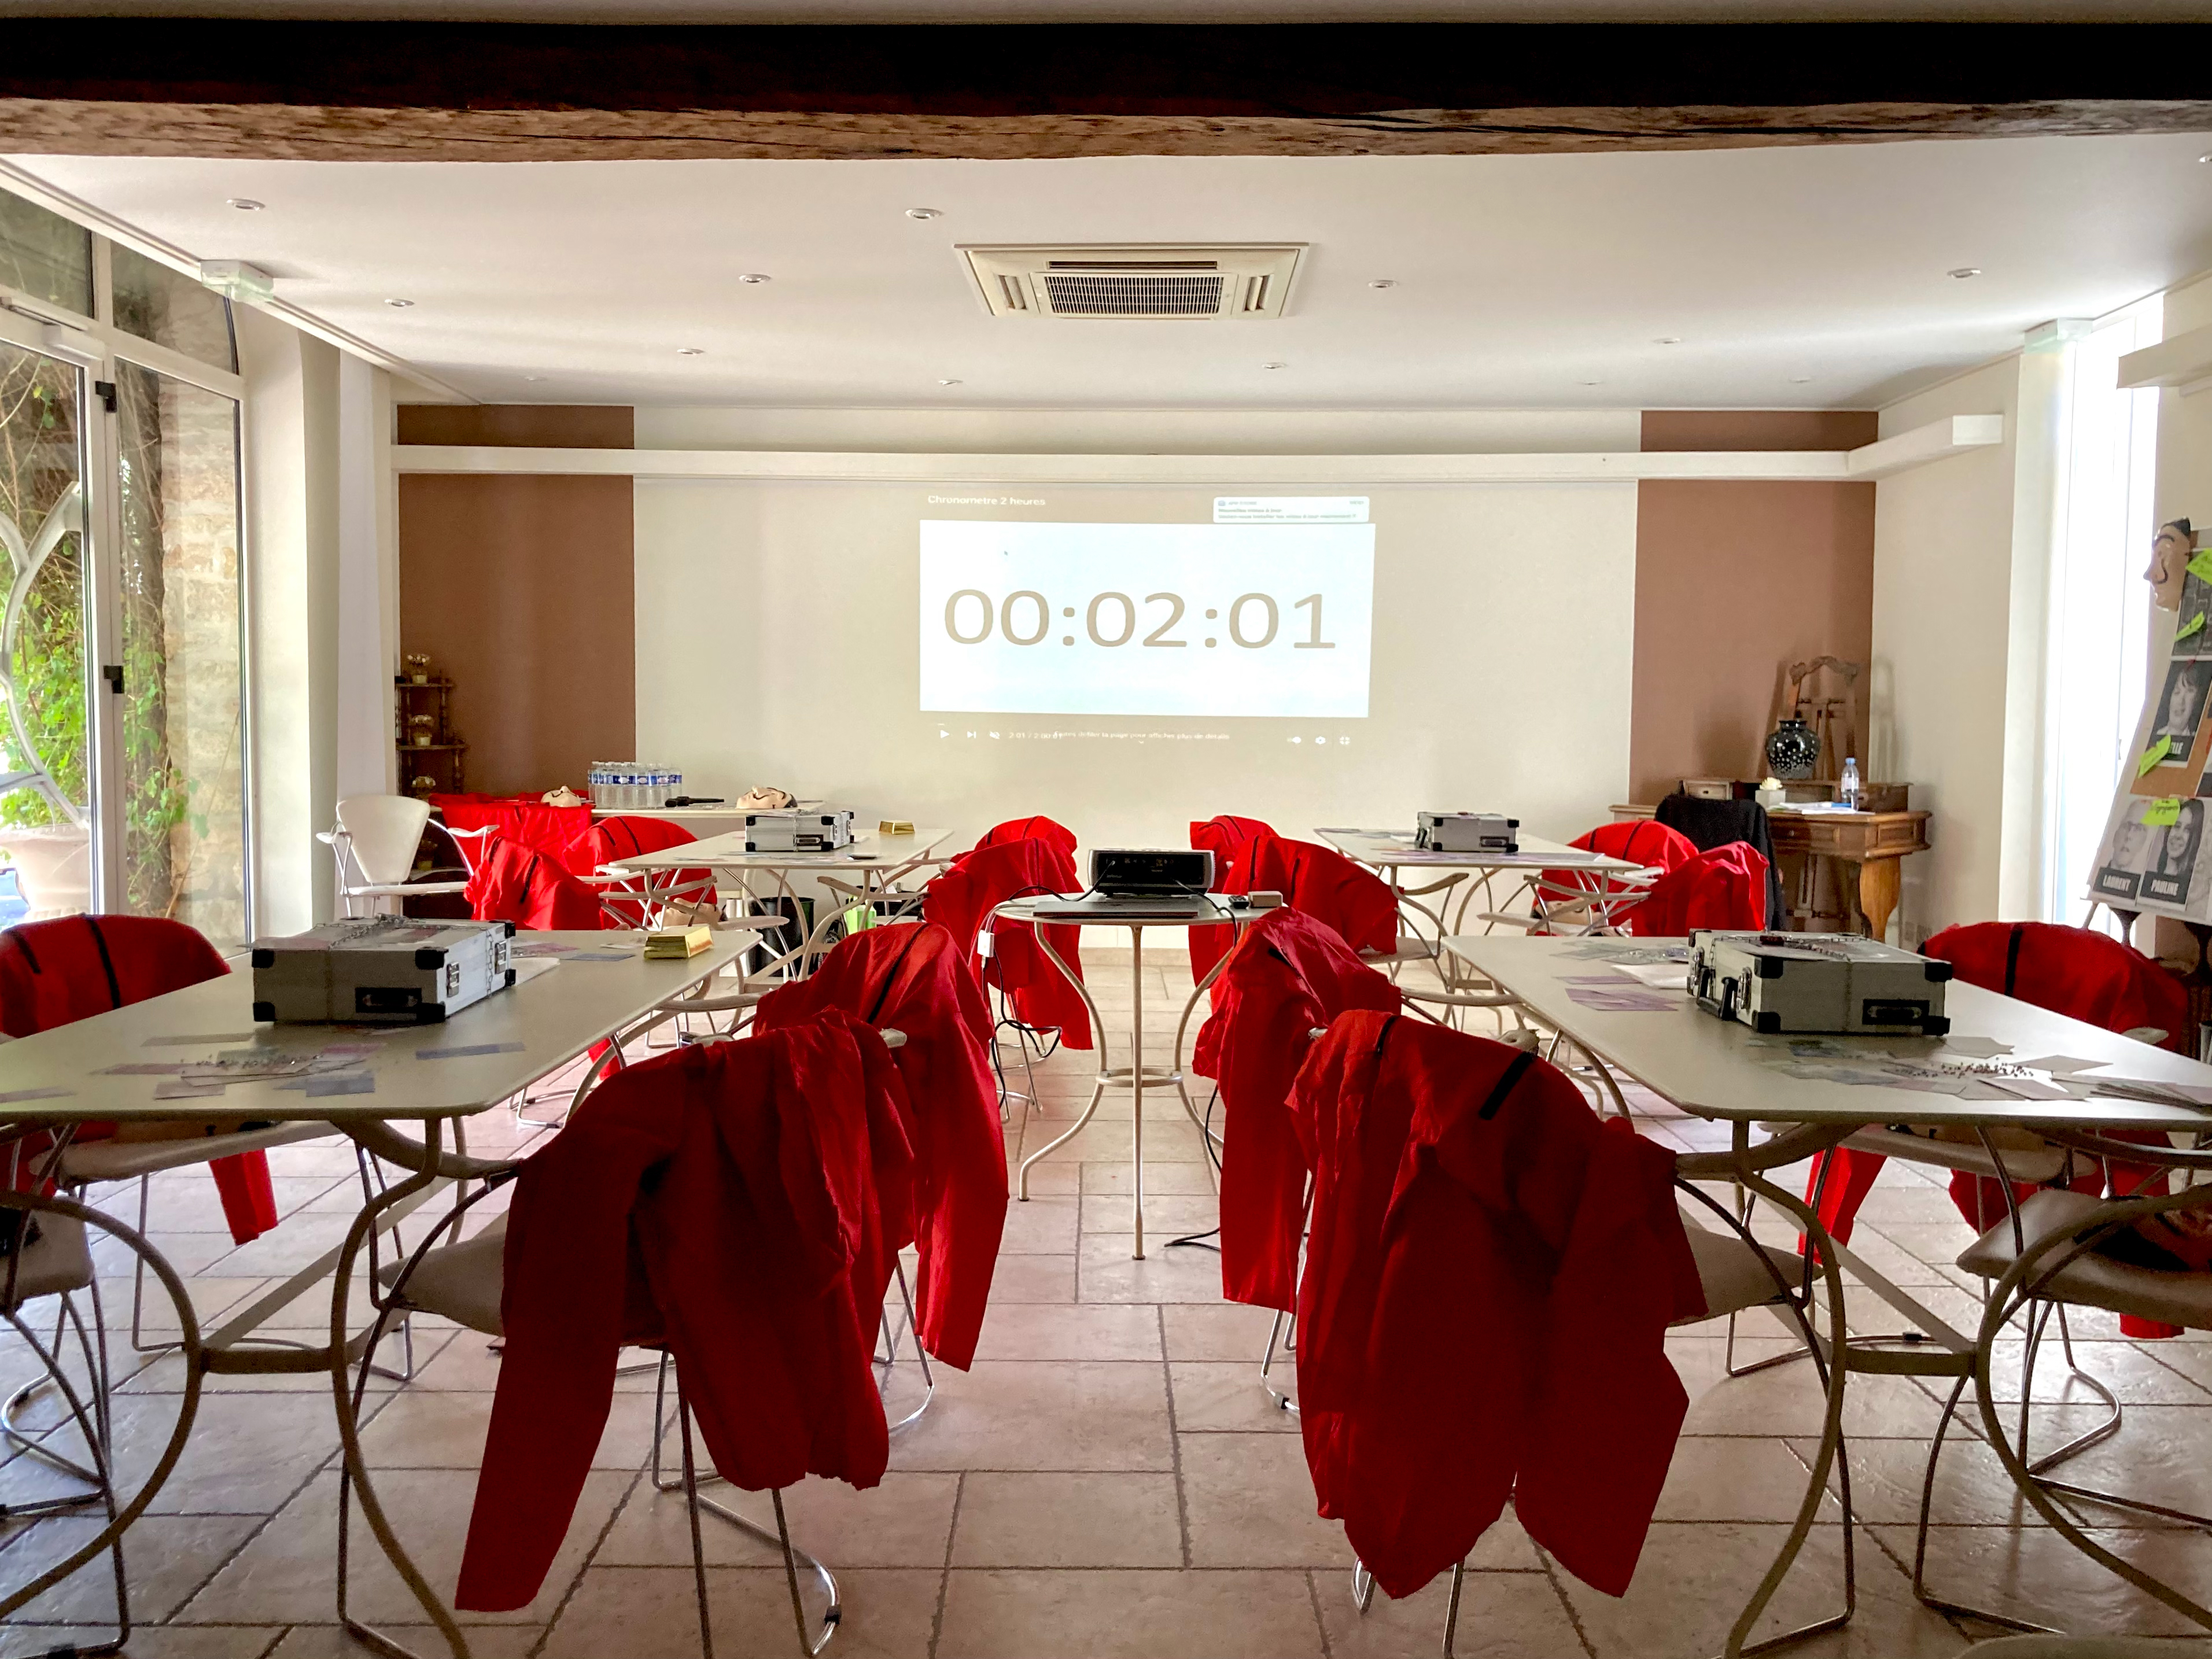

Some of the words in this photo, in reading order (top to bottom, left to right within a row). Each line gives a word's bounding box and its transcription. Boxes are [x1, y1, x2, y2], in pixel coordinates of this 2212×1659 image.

[1000, 497, 1007, 505] 2
[1009, 497, 1046, 506] heures
[944, 588, 1336, 649] 00:02:01
[2102, 874, 2131, 892] LAURENT
[2150, 879, 2179, 896] PAULINE
